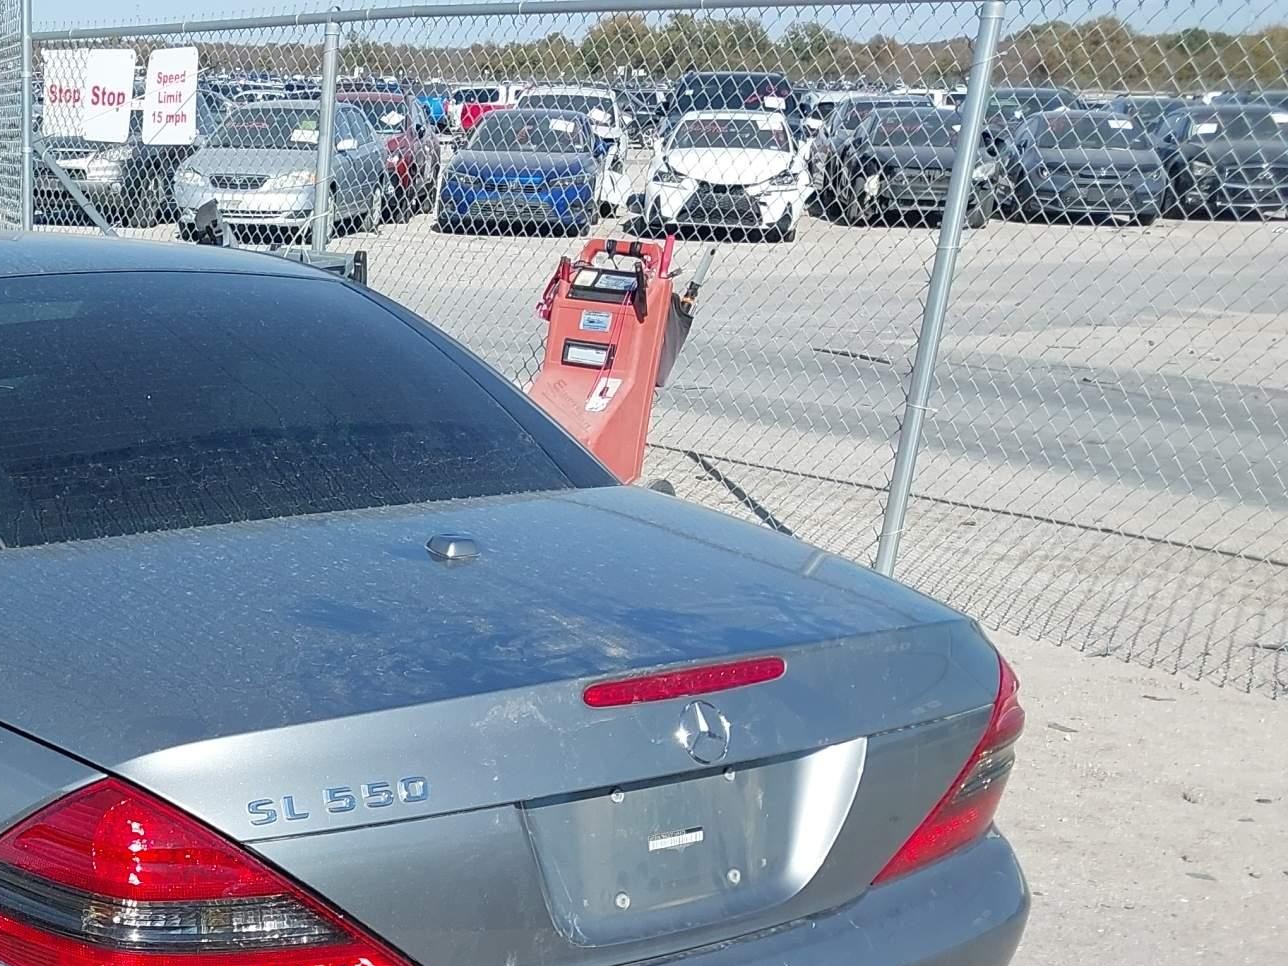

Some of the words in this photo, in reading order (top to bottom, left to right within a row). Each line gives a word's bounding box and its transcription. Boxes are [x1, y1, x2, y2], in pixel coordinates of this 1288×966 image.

[156, 71, 186, 86] Speed
[49, 84, 81, 108] Stop
[91, 85, 126, 111] Stop
[158, 91, 182, 104] Limit
[152, 111, 162, 124] 15
[165, 111, 187, 126] mph
[247, 796, 309, 826] SL
[322, 776, 431, 814] 550
